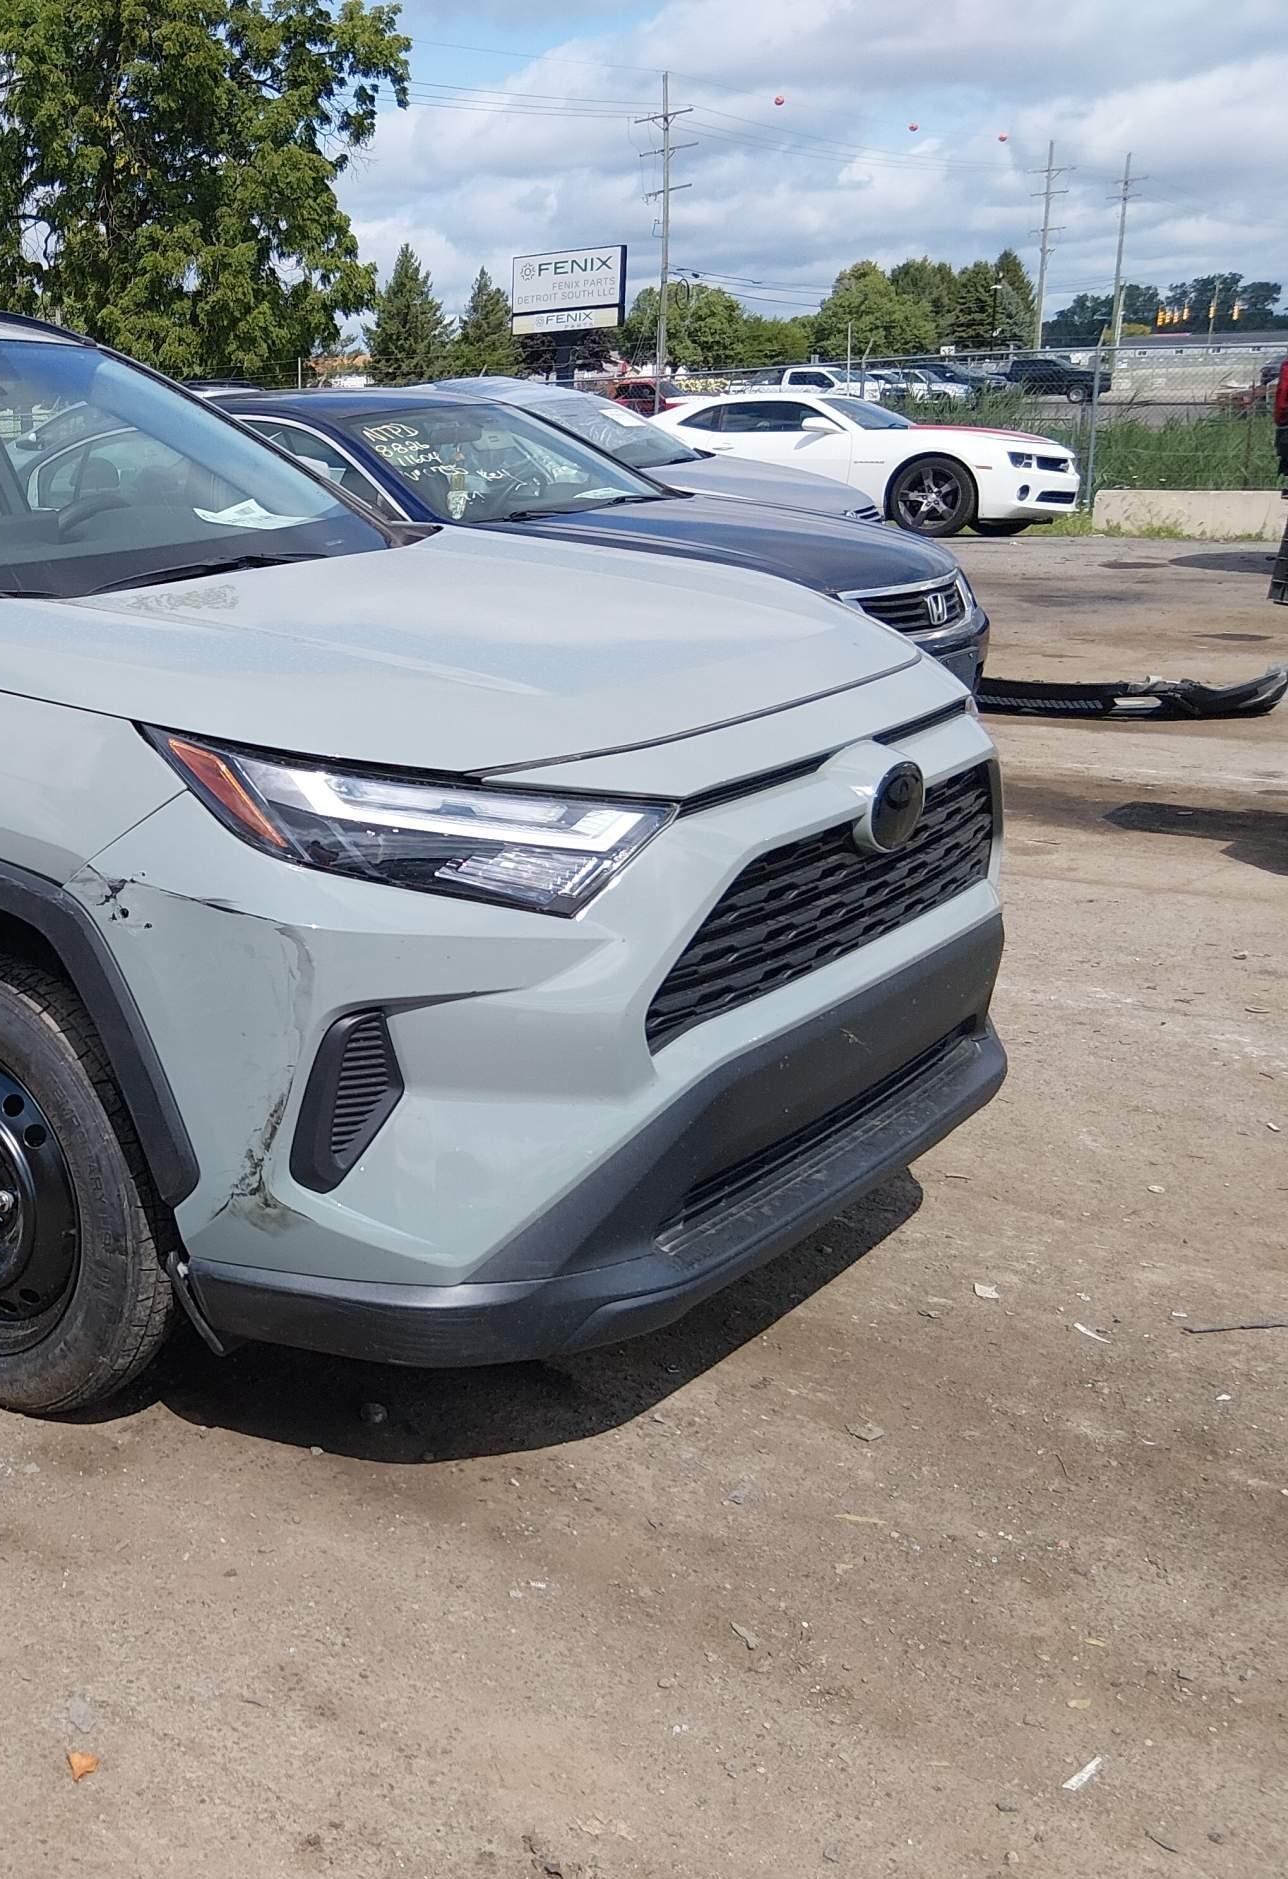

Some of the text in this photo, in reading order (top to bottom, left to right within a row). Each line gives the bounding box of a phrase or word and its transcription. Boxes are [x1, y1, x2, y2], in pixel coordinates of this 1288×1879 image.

[538, 255, 613, 277] FENIX
[552, 276, 616, 290] FENIX PARTS
[517, 288, 615, 305] DETROIT SOUTH LLC
[545, 311, 593, 325] FENIX
